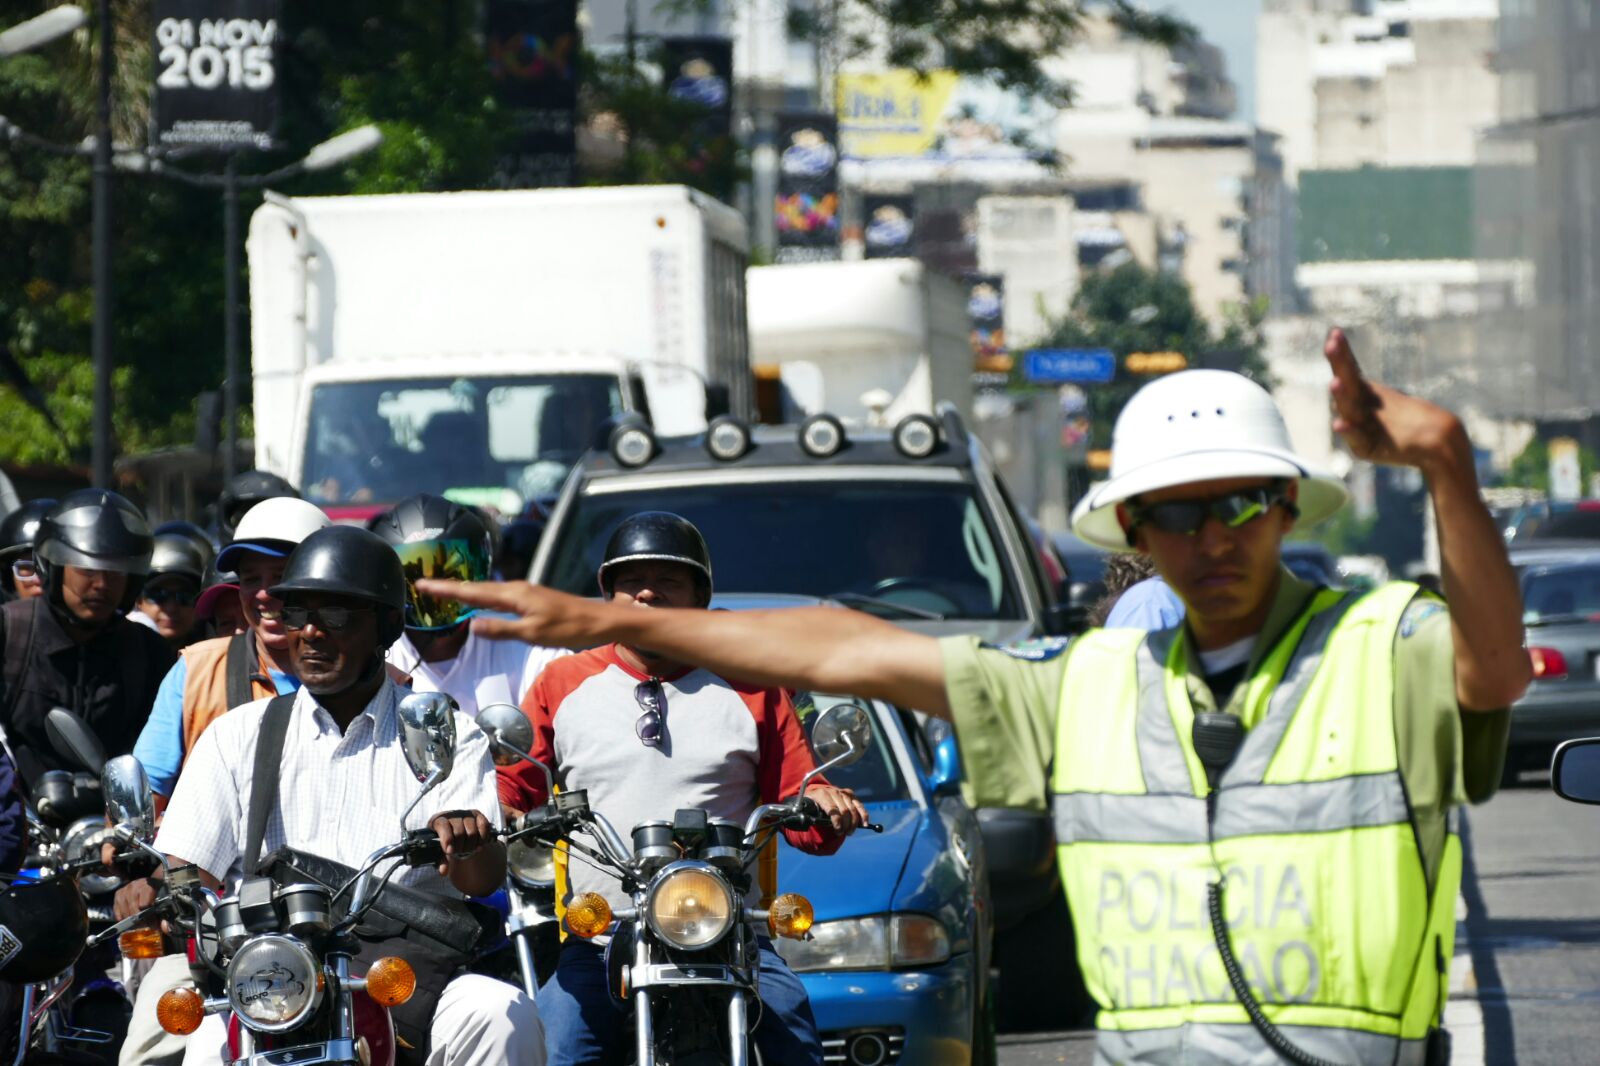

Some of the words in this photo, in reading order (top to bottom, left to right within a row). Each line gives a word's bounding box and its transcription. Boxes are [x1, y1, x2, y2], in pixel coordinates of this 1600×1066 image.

[156, 17, 194, 47] 01
[199, 18, 277, 47] NOV
[157, 44, 275, 90] 2015
[1096, 865, 1313, 934] POLICIA
[245, 990, 269, 1003] MOTO
[1098, 940, 1319, 1008] CHACAO
